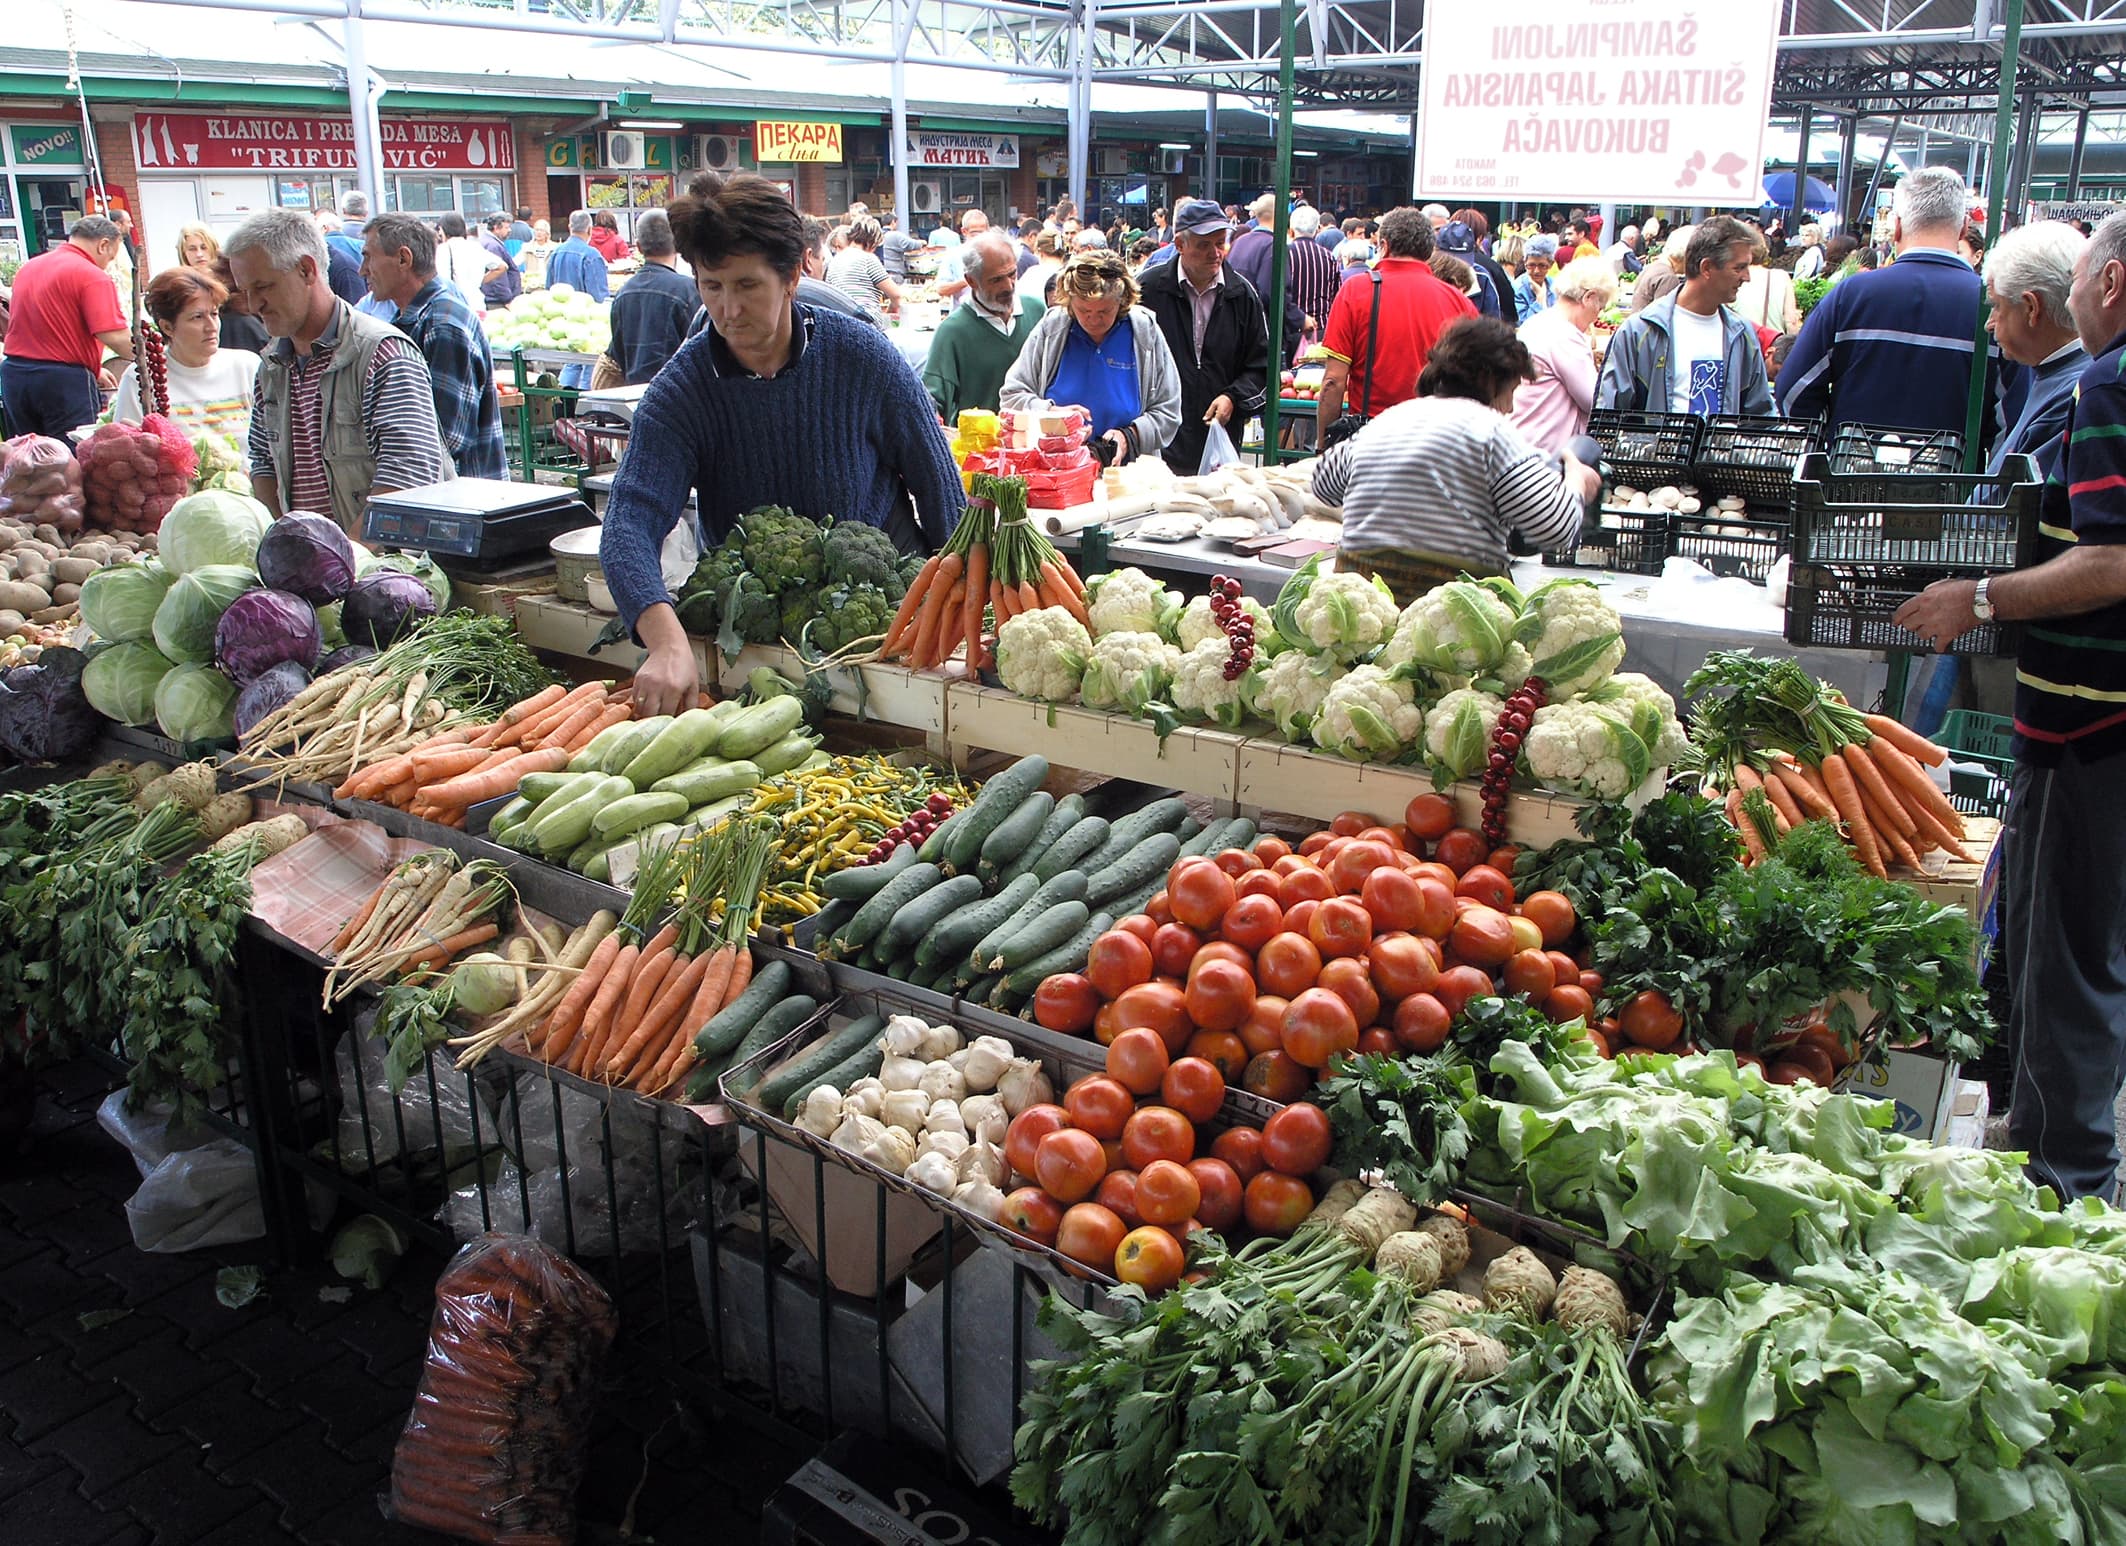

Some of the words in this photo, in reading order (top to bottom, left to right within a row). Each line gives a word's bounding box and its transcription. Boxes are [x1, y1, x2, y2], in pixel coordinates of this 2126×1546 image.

[206, 119, 300, 140] KLANICA
[304, 121, 313, 140] I
[318, 122, 409, 142] PREDA
[413, 124, 463, 143] MESA
[760, 123, 840, 153] ПЕКАРА
[919, 133, 969, 148] ИНДУСТРИЈА
[969, 136, 993, 149] МЕСА
[23, 130, 74, 161] NOVO!!
[231, 145, 447, 168] "TRIFUNVIĆ"
[923, 148, 991, 165] МАТИЋ
